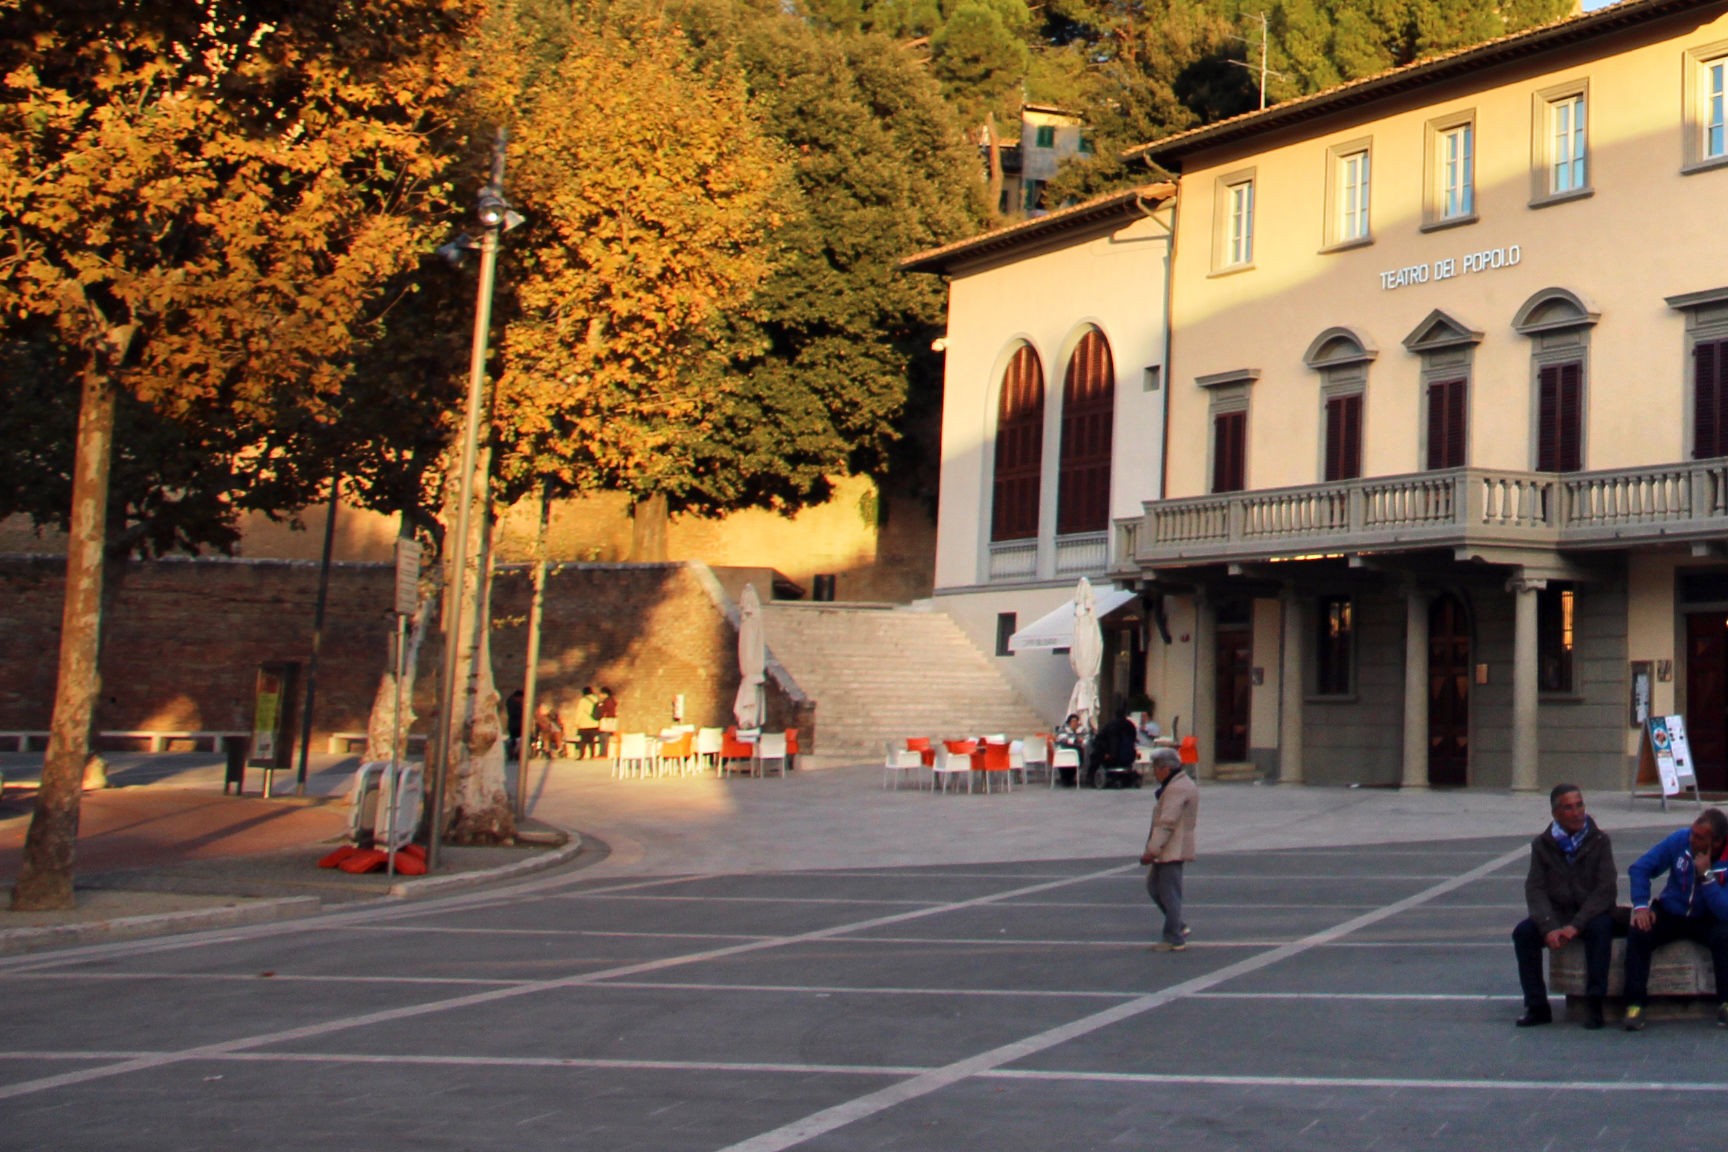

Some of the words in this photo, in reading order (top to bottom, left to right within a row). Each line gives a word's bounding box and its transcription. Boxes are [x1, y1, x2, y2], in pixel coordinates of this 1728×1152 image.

[1380, 264, 1430, 290] TEATRO
[1434, 259, 1457, 281] DEL
[1463, 245, 1521, 274] POPOLO
